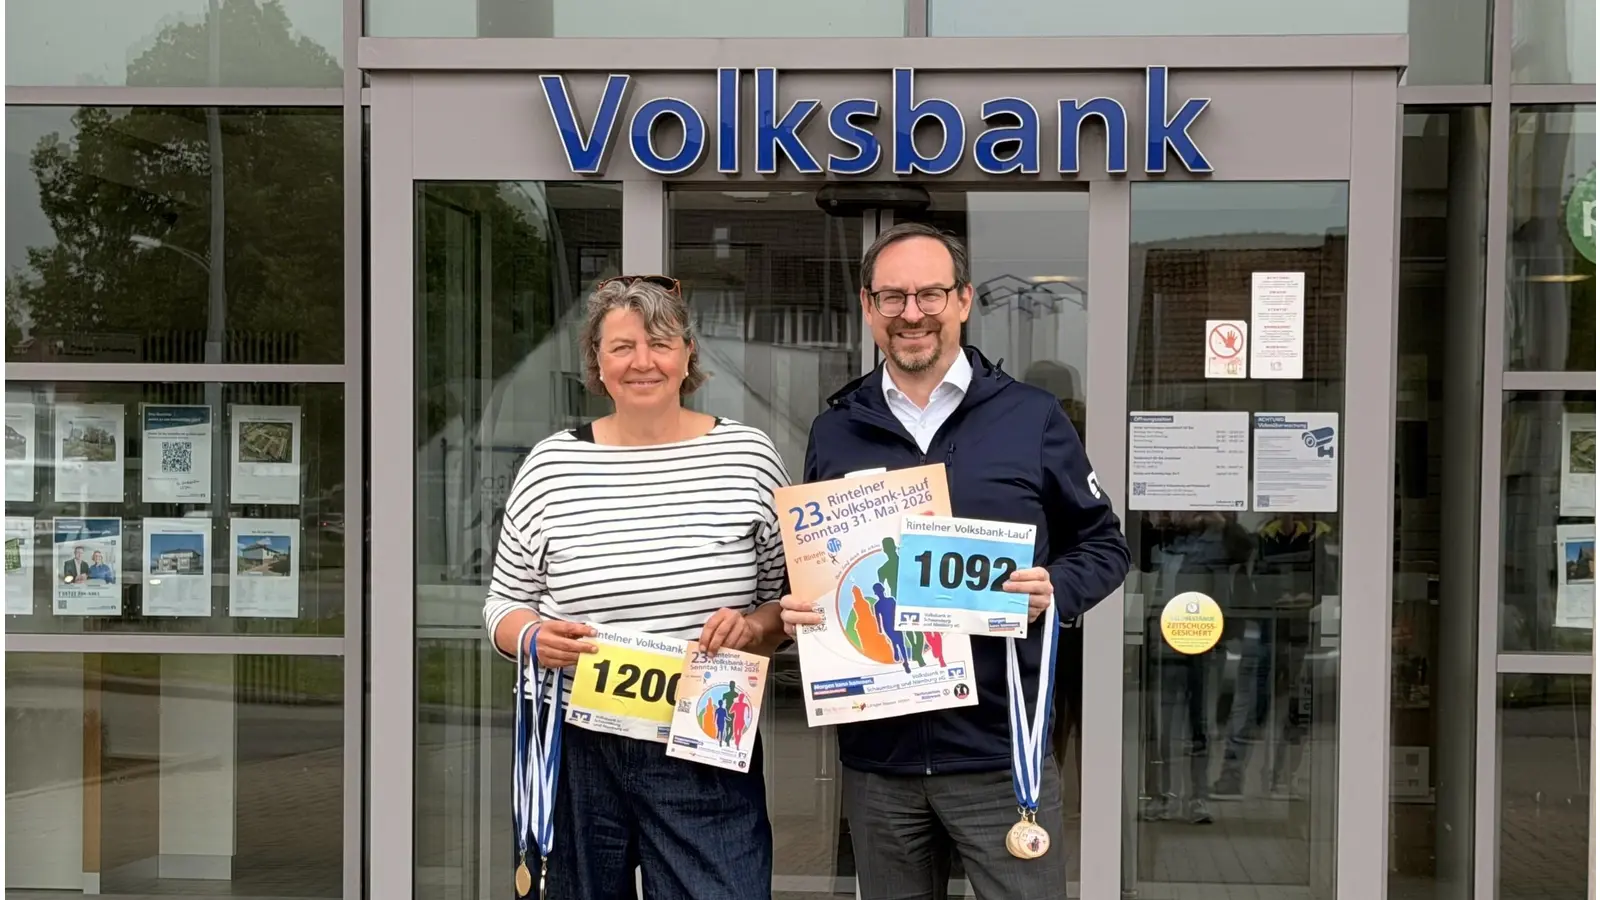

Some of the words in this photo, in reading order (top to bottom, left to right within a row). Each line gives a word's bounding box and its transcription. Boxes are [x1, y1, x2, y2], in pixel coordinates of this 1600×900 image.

[540, 67, 1214, 174] Volksbank
[827, 479, 885, 507] Rintelner
[832, 478, 930, 520] Volksbank-Lauf
[789, 501, 832, 532] 23.
[796, 520, 850, 546] Sonntag
[852, 512, 872, 528] 31.
[874, 503, 900, 518] Mai
[903, 490, 933, 510] 2026
[906, 520, 951, 532] Rintelner
[955, 523, 1030, 540] Volksbank-Lauf
[915, 550, 1018, 592] 1092
[692, 652, 710, 664] 23.
